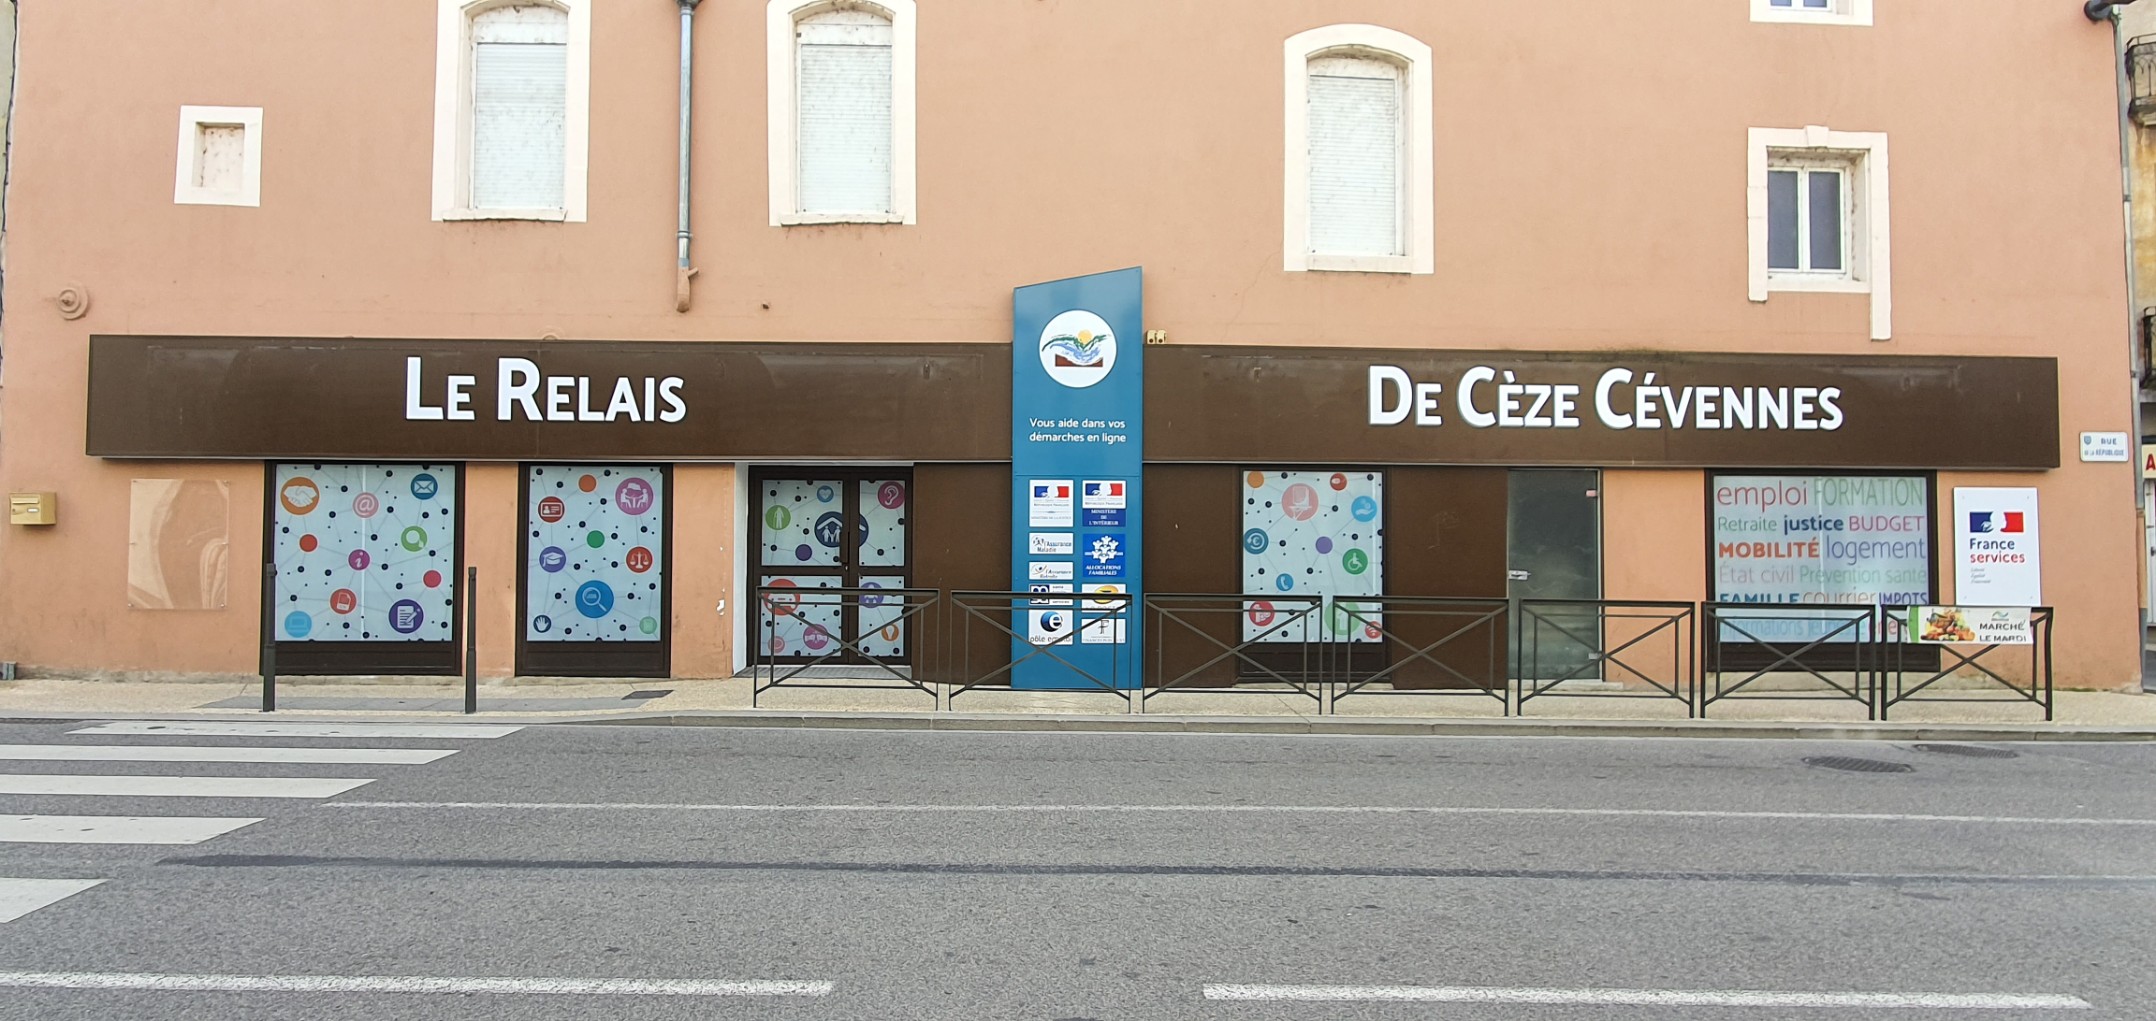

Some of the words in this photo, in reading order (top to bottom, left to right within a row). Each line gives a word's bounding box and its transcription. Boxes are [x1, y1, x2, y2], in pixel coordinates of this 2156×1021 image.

[1029, 418, 1055, 428] Vous
[1058, 418, 1079, 428] aide
[1081, 418, 1105, 428] dans
[1108, 420, 1126, 429] vos
[1029, 431, 1085, 442] démarches
[1087, 434, 1100, 442] en
[1101, 432, 1127, 445] ligne
[1716, 480, 1808, 513] emploi
[1813, 478, 1925, 506] FORMATION
[1717, 516, 1778, 532] Retraite
[1783, 514, 1844, 535] justice
[1848, 515, 1925, 532] BUDGET
[1718, 537, 1820, 558] MOBILITÉ
[1826, 535, 1927, 565] logement
[1969, 538, 2016, 550] France
[1969, 551, 2026, 563] services
[1719, 561, 1756, 584] État
[1760, 564, 1794, 584] civil
[1800, 564, 1881, 584] Prévention
[1885, 565, 1927, 584] santé
[1979, 619, 2026, 631] MARCHÉ
